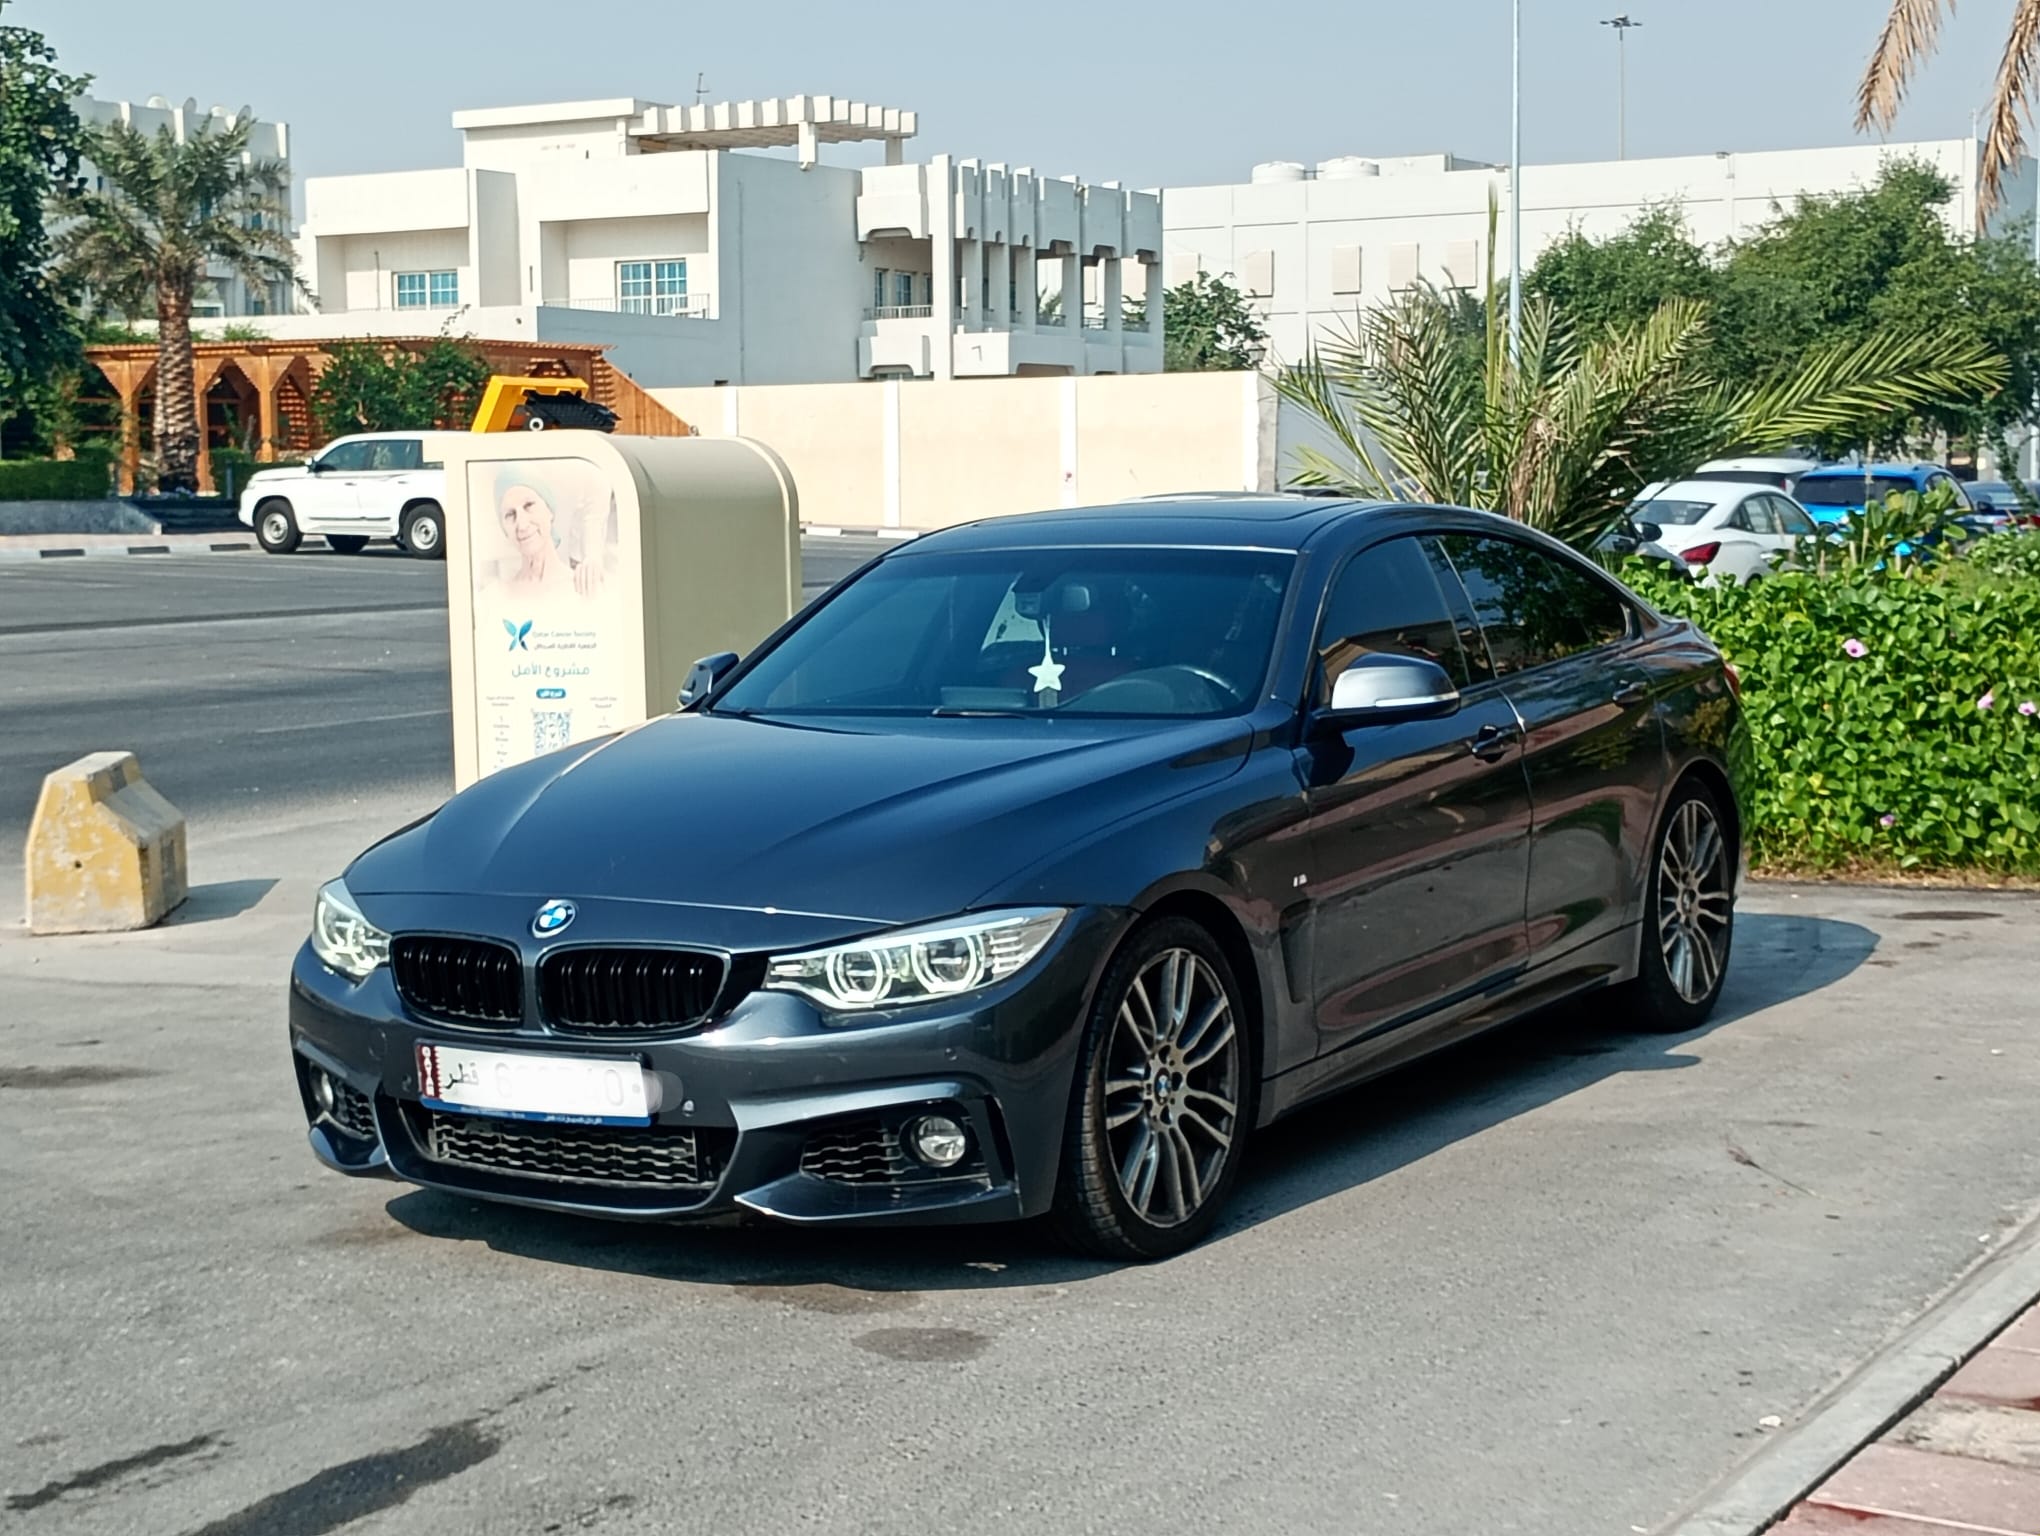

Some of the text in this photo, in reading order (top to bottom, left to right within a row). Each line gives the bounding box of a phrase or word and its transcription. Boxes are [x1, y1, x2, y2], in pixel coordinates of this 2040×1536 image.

[511, 661, 590, 678] مشروع الأمل
[441, 1062, 478, 1090] قطر
